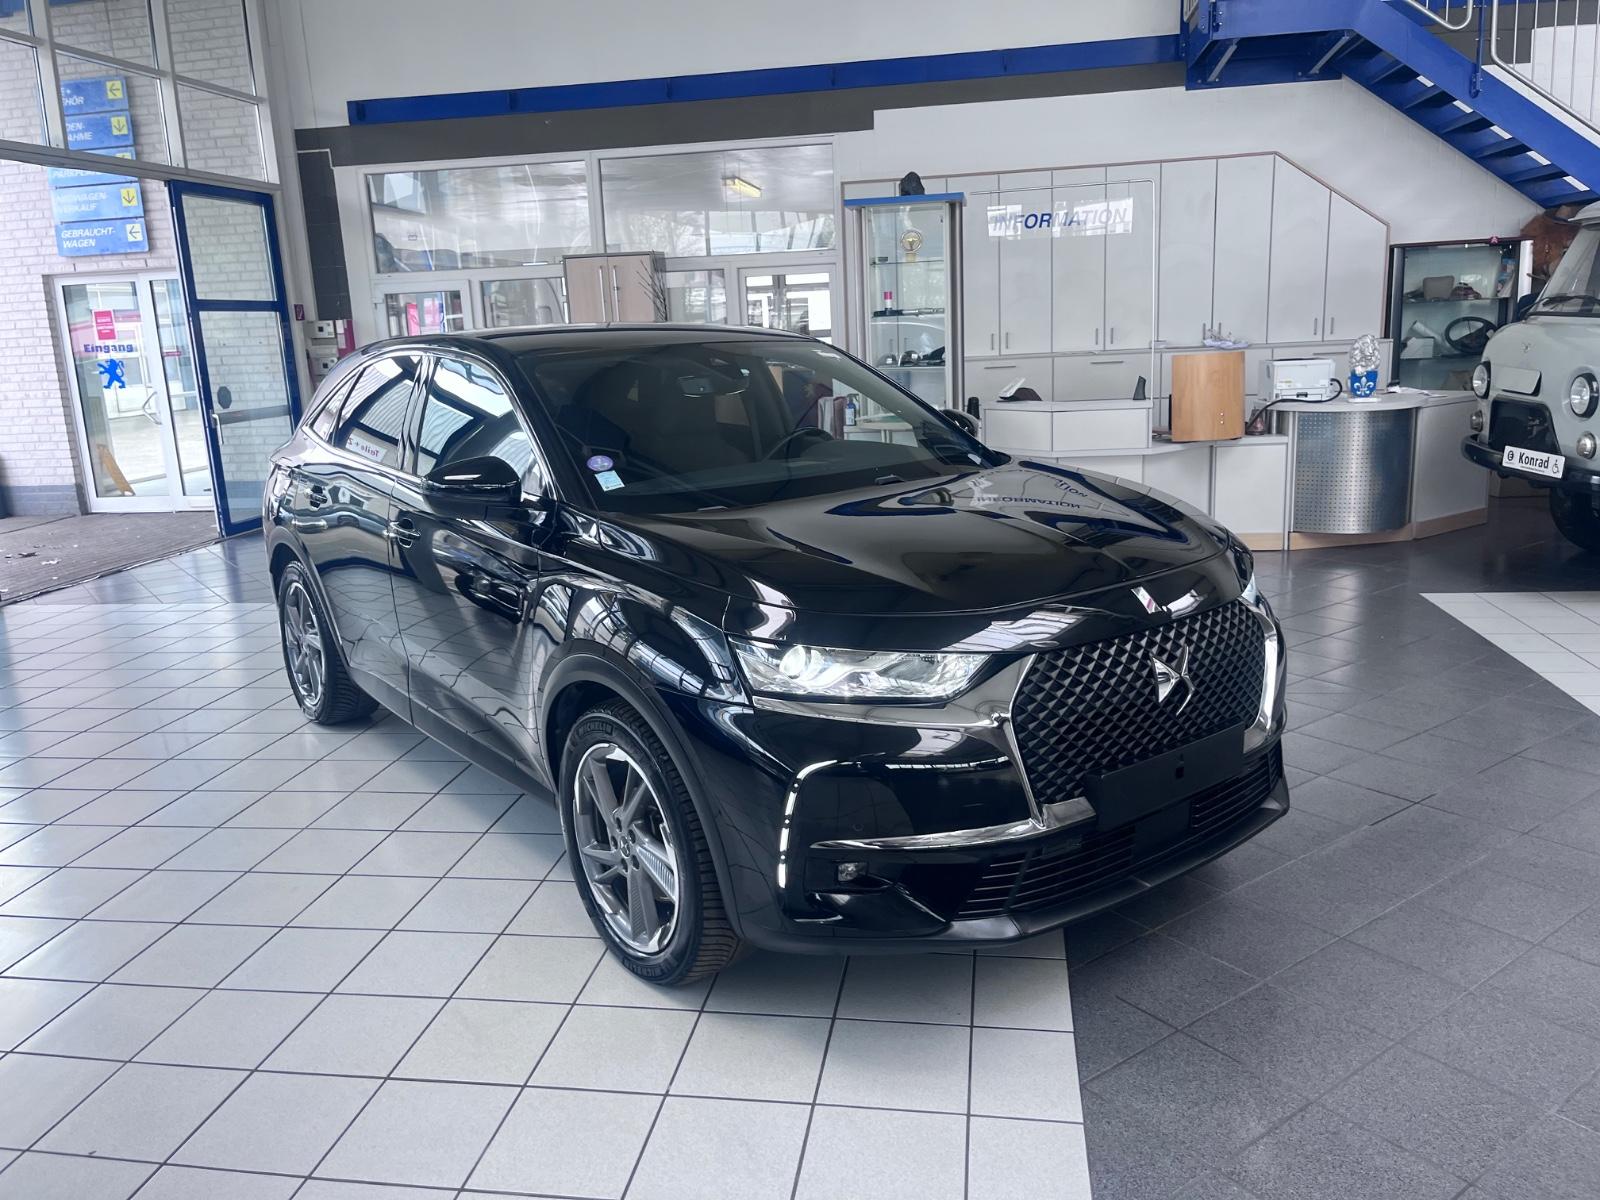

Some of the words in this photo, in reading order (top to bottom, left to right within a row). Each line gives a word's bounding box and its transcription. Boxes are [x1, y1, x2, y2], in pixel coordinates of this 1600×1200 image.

[62, 95, 85, 106] HÖR
[993, 206, 1128, 233] INFORMATION
[61, 226, 116, 239] GEBRAUCHT-
[63, 238, 96, 249] WAGEN
[84, 343, 134, 354] Eingang
[1518, 451, 1550, 469] Konrad
